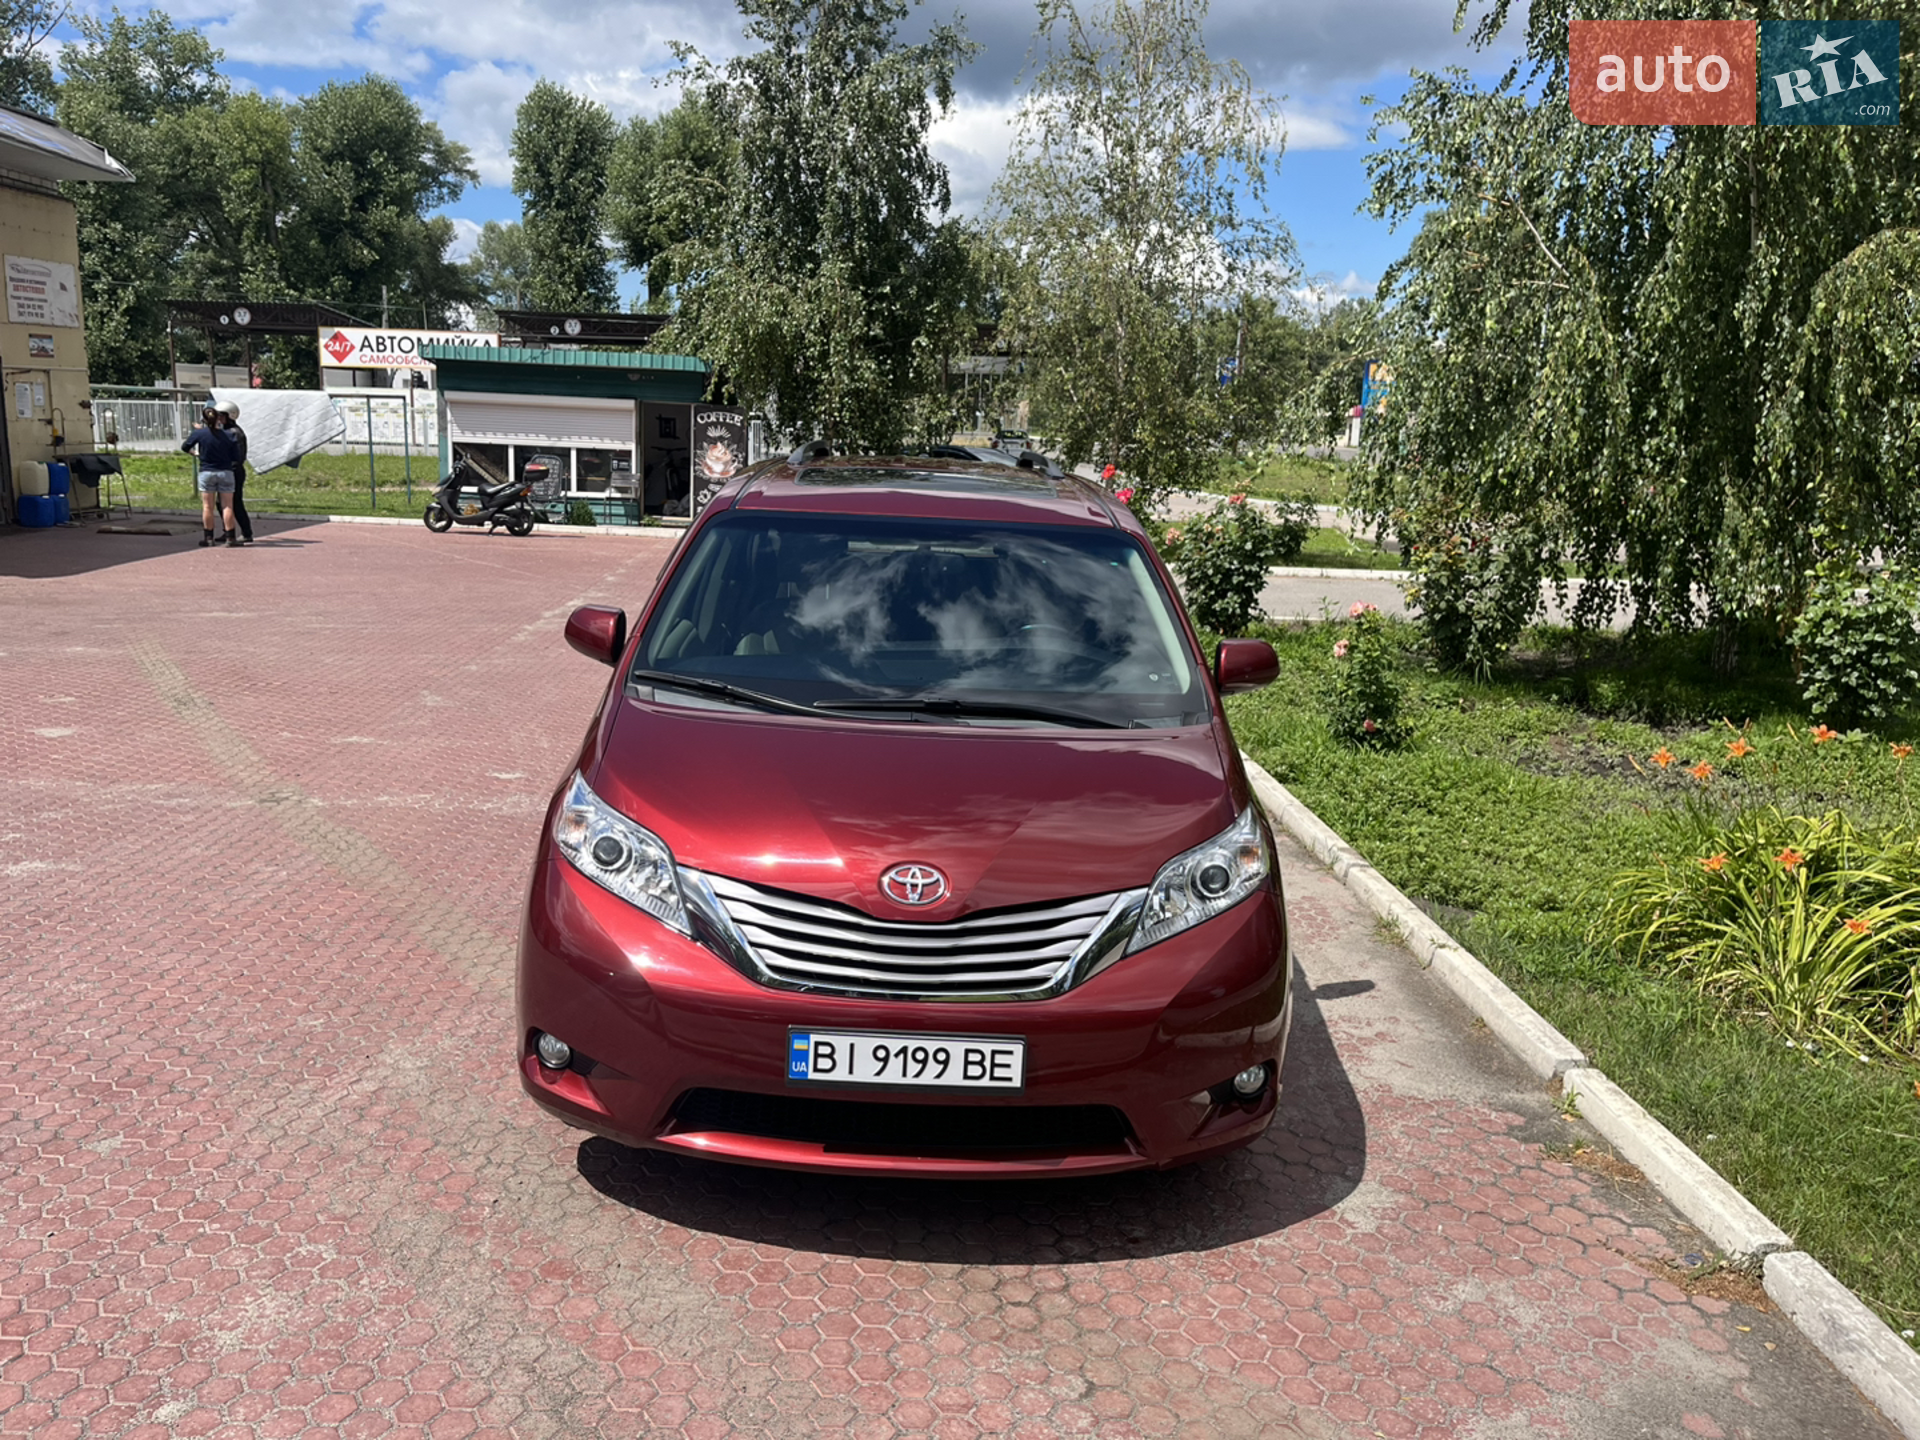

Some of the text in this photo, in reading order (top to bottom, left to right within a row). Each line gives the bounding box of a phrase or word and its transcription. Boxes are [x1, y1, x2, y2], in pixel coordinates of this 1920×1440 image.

[327, 341, 352, 352] 24/7
[359, 354, 432, 365] САМООБСЛ
[696, 411, 743, 426] COFFEE
[792, 1061, 808, 1072] UA
[812, 1040, 1014, 1082] BI 9199 BE
